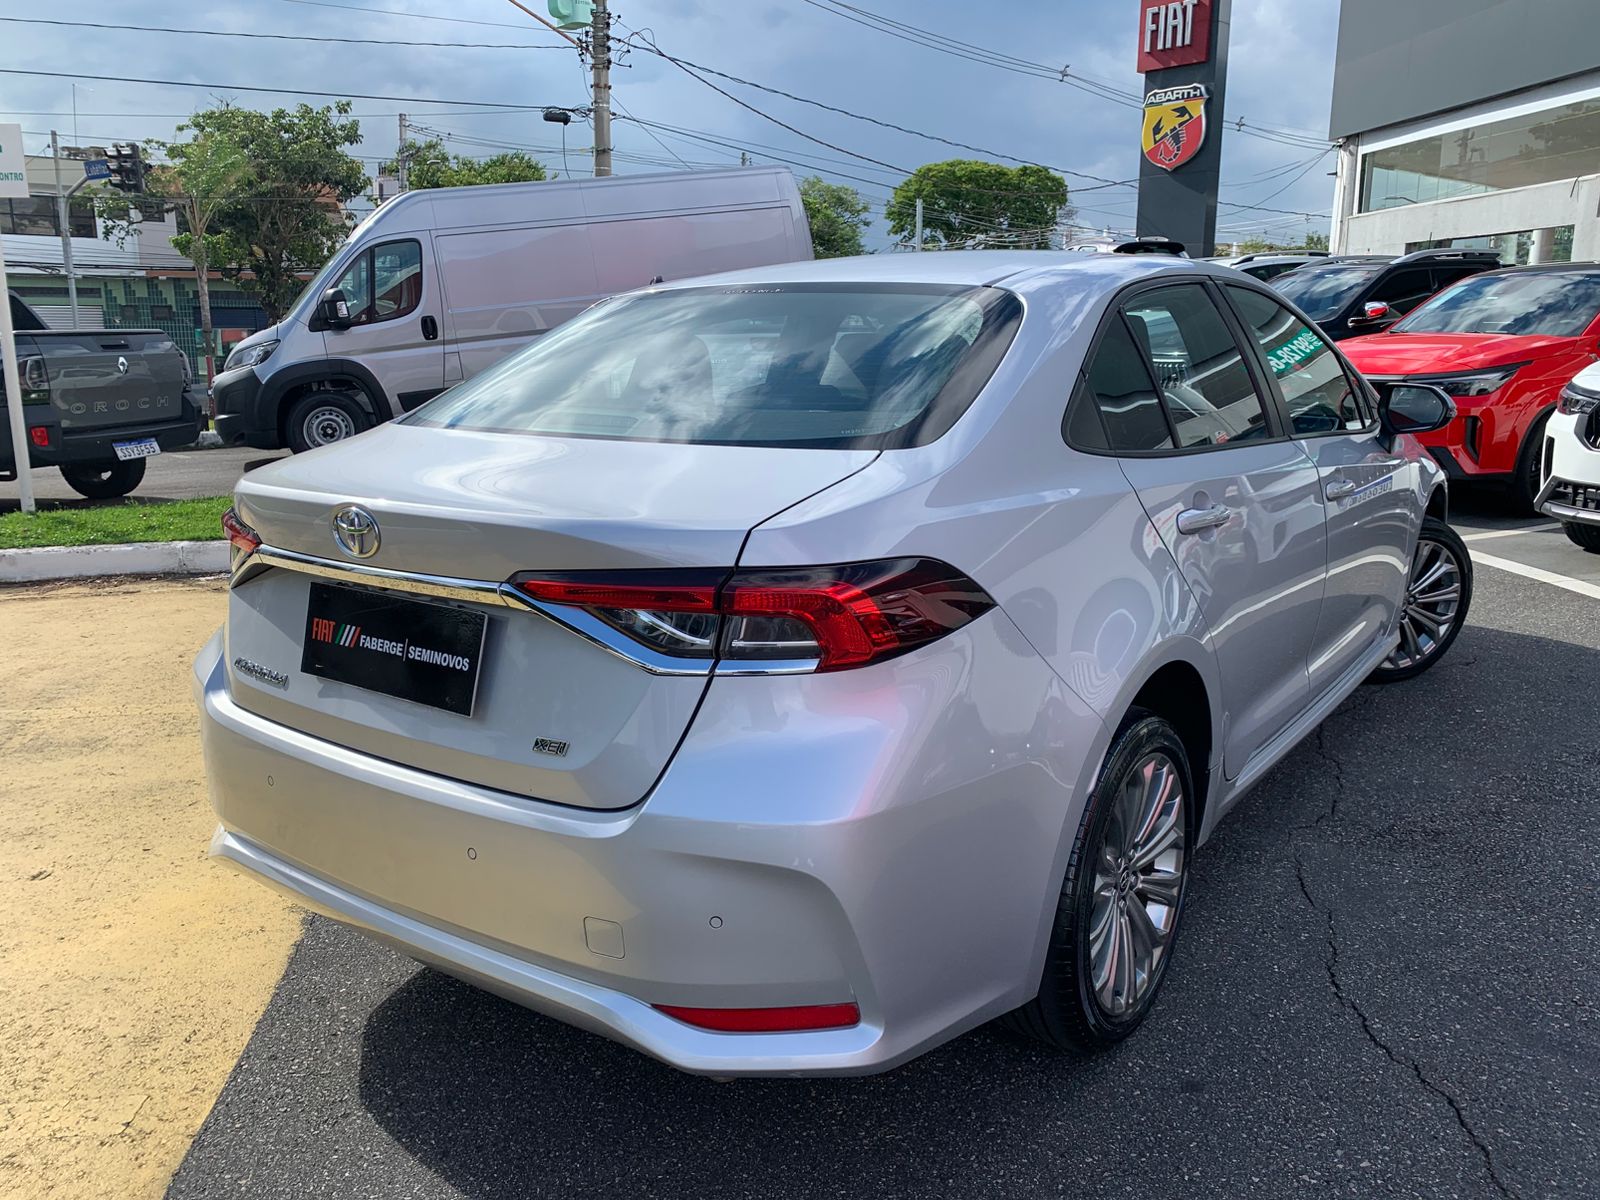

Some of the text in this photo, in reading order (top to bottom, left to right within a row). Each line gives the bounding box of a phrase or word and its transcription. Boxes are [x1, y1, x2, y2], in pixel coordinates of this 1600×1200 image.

[1144, 0, 1198, 53] FIAT
[1147, 89, 1200, 104] ABARTH
[71, 396, 168, 414] OROCH
[312, 617, 470, 672] FIAT FABERGE SEMINOVOS
